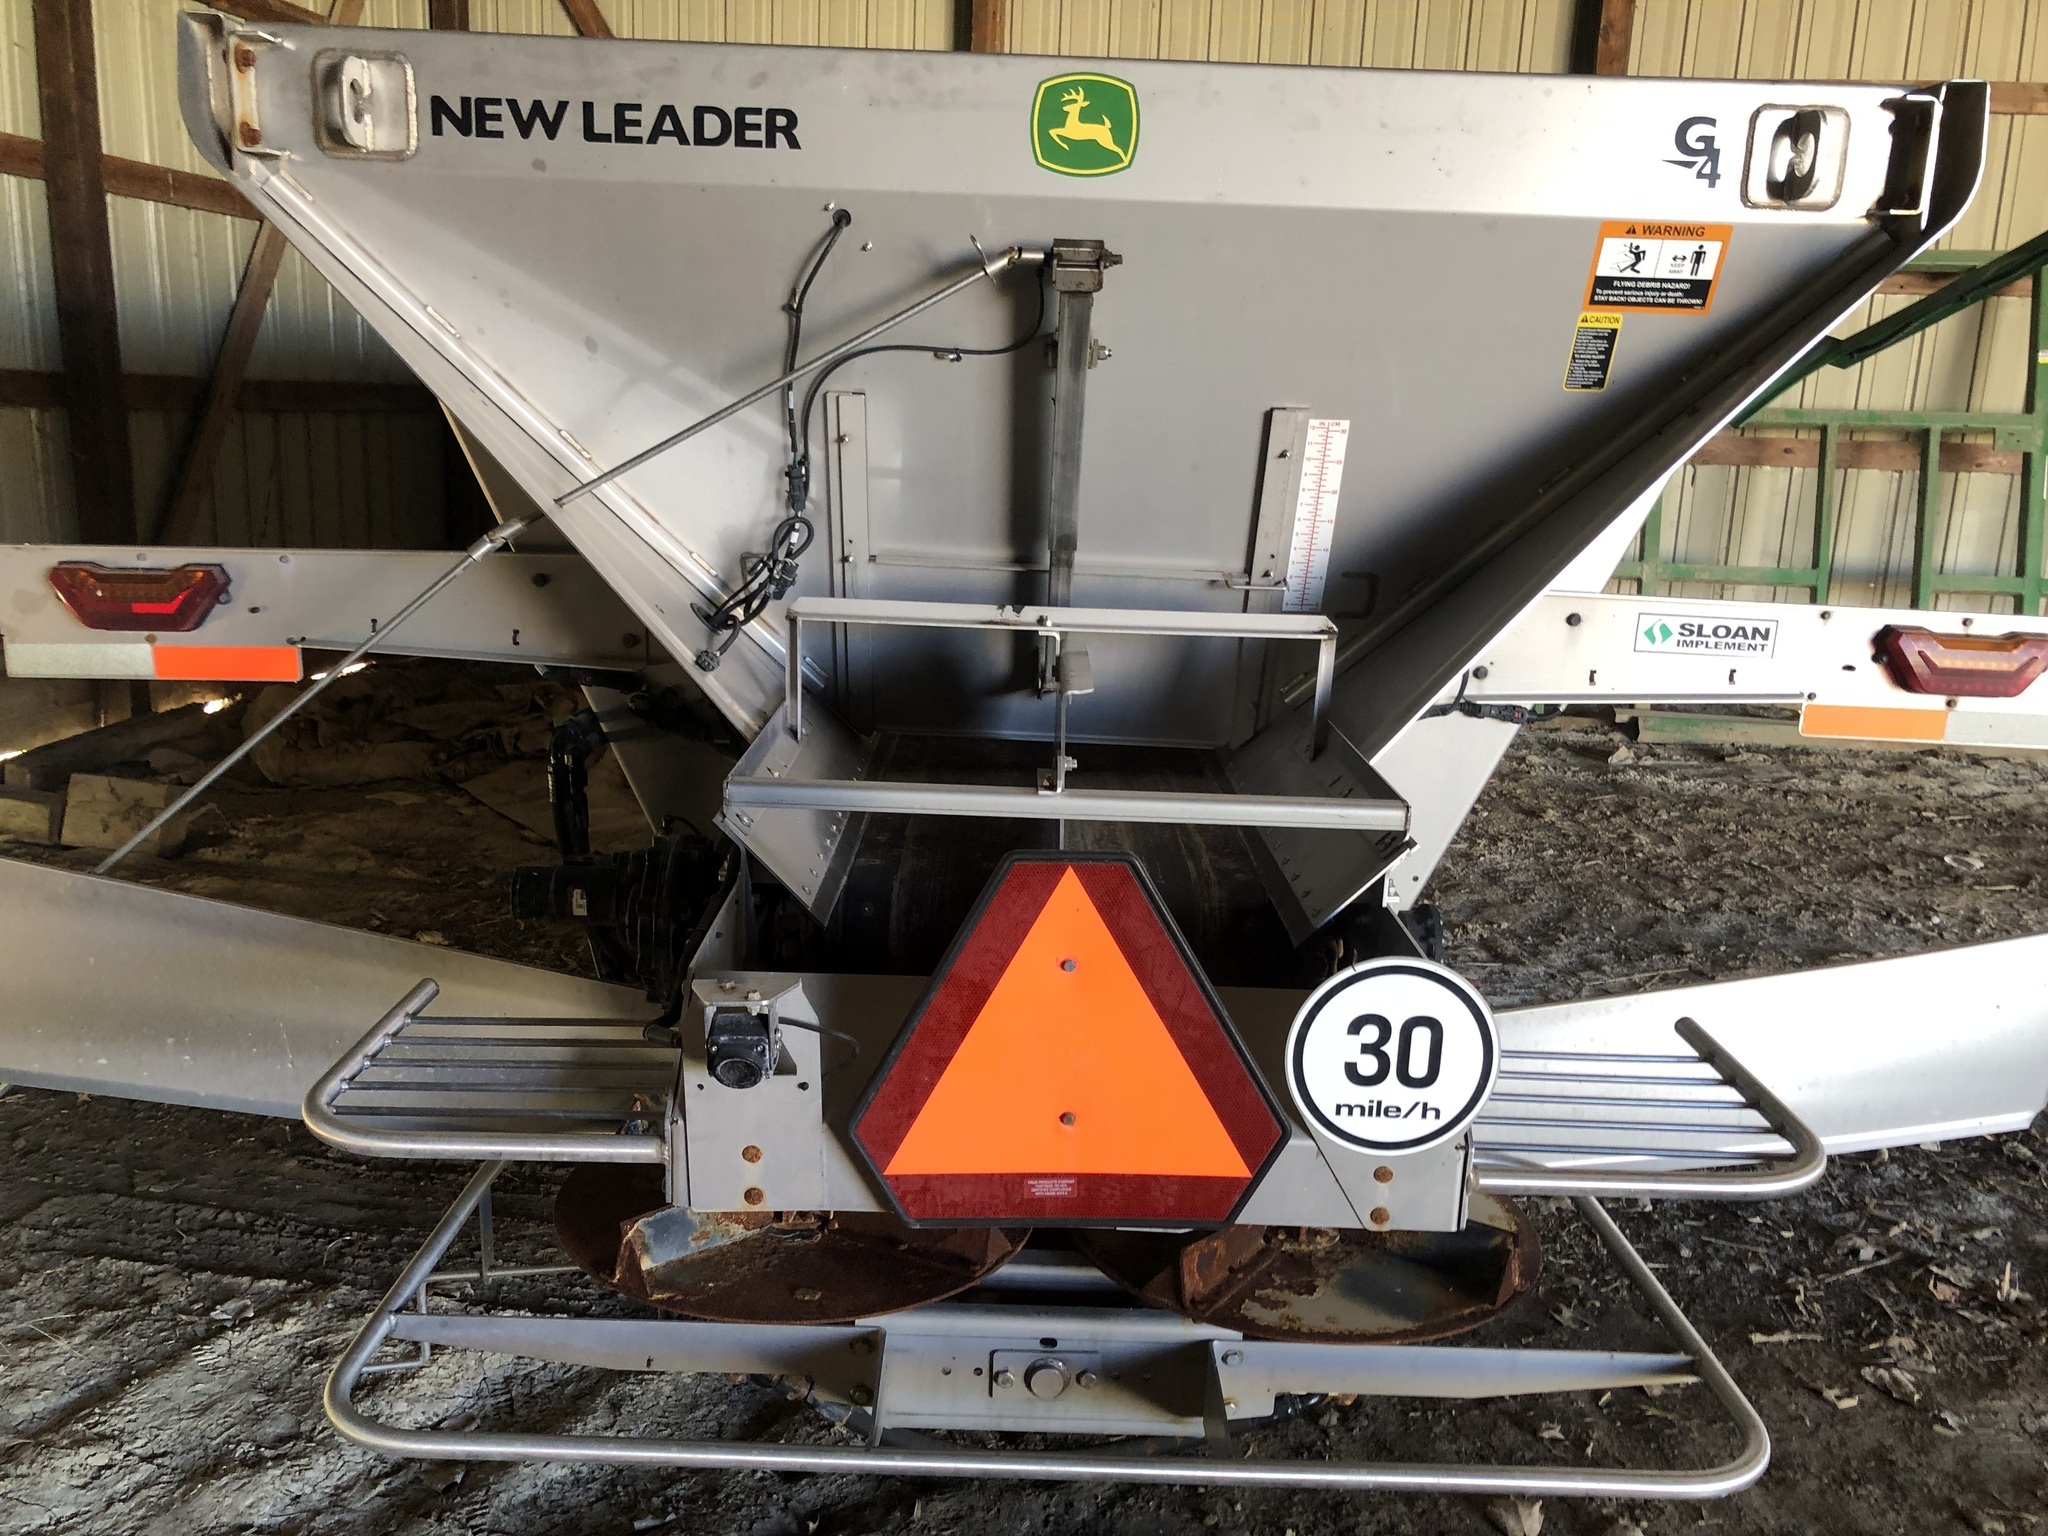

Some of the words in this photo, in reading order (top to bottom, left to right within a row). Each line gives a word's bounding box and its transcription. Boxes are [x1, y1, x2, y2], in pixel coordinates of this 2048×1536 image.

[430, 95, 570, 141] NEW
[581, 101, 802, 150] LEADER
[1674, 116, 1721, 189] G4
[1642, 225, 1706, 237] WARNING
[1678, 622, 1770, 642] SLOAN
[1676, 639, 1768, 652] IMPLEMENT
[1344, 1013, 1444, 1089] 30
[1334, 1100, 1441, 1120] mile/h
